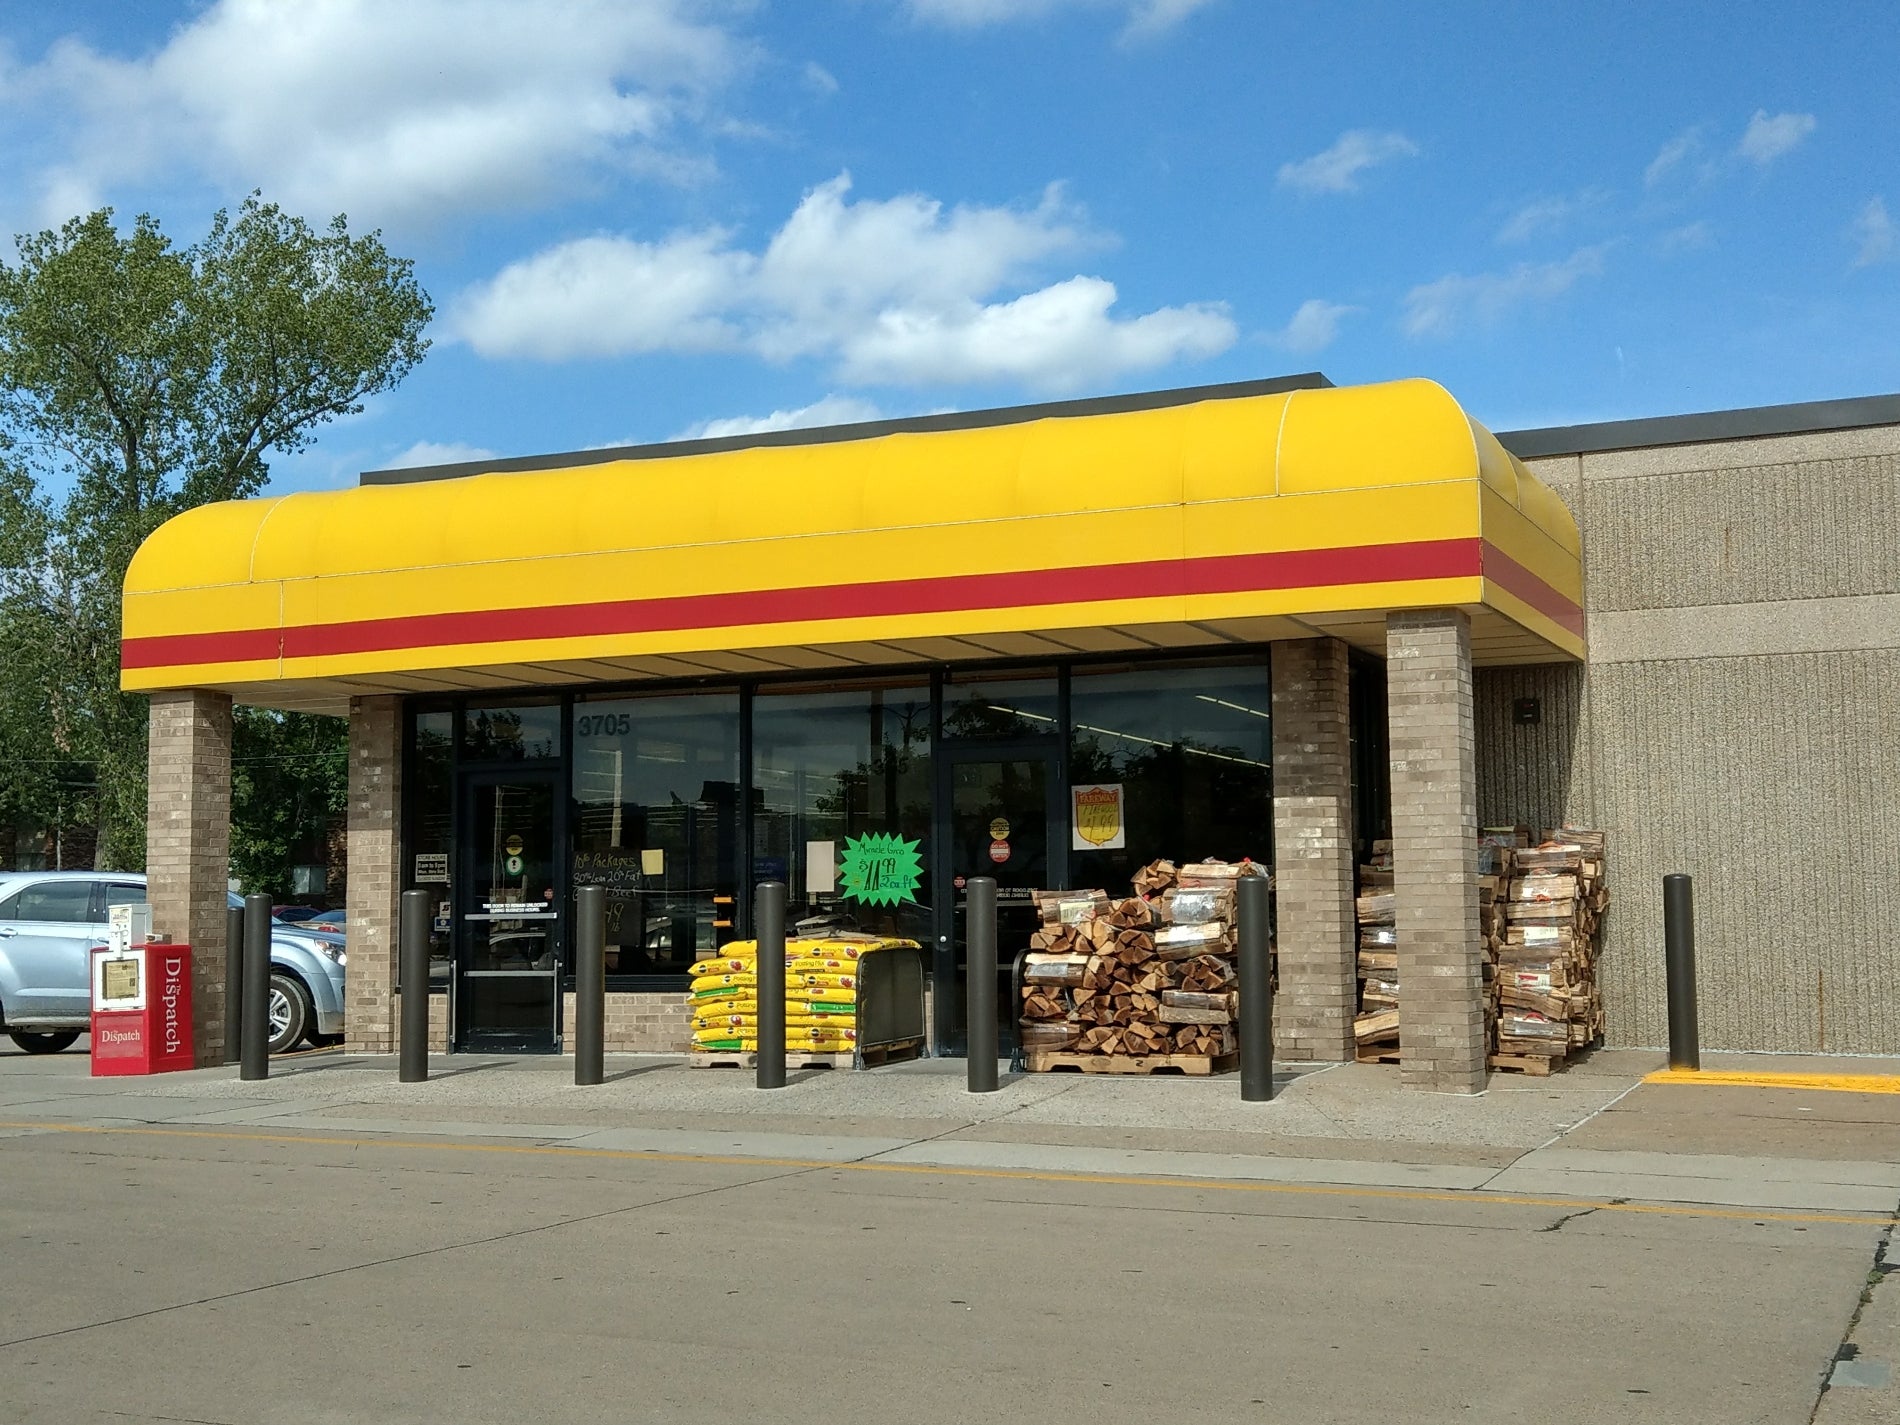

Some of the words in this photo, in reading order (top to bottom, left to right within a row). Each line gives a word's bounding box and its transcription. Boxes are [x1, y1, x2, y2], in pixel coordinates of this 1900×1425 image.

[579, 714, 631, 736] 3705
[592, 852, 637, 871] Packages
[625, 869, 642, 881] Fat
[162, 957, 181, 1054] Dispatch
[102, 1031, 140, 1044] Dispatch
